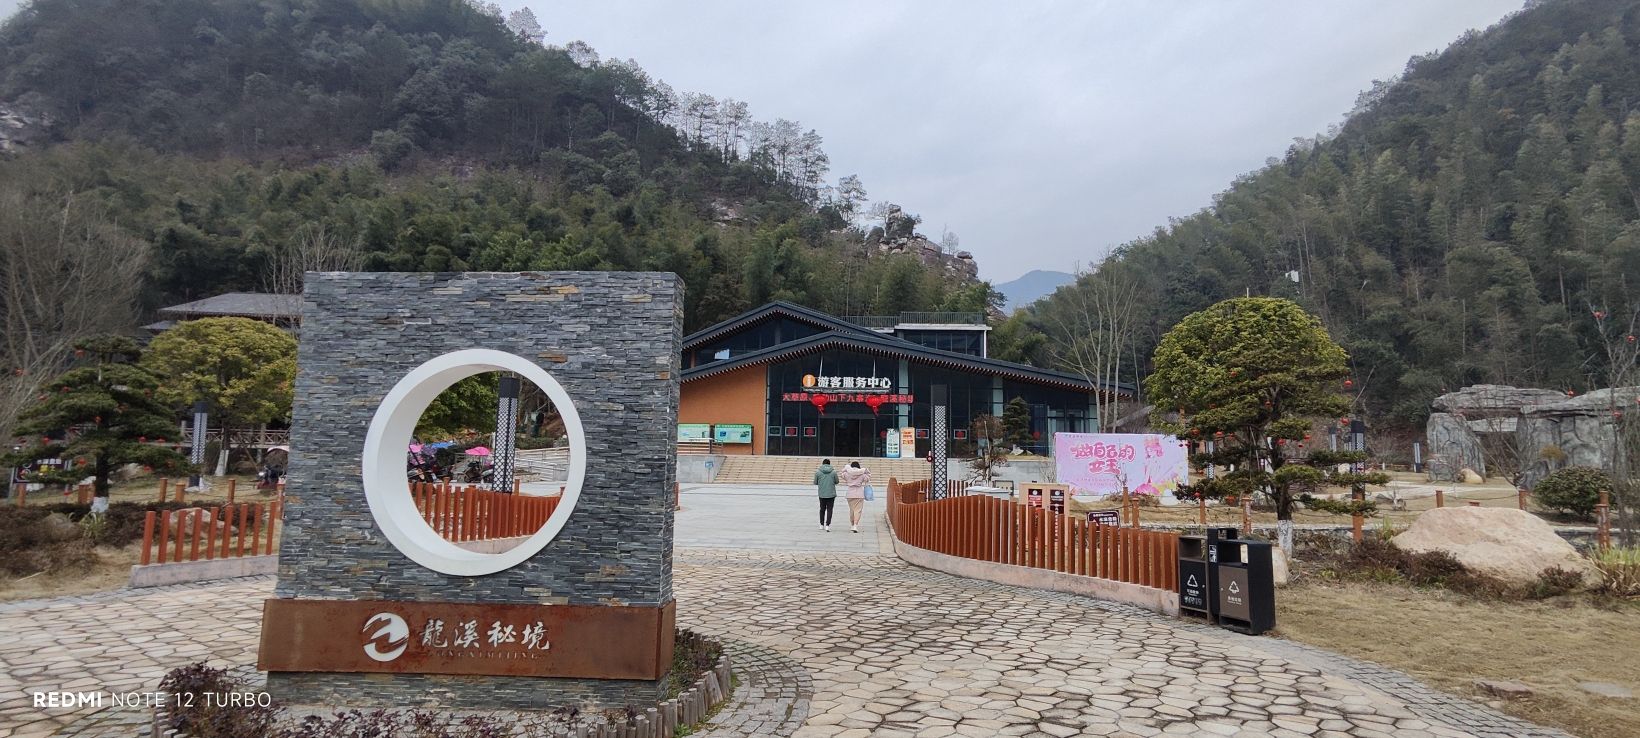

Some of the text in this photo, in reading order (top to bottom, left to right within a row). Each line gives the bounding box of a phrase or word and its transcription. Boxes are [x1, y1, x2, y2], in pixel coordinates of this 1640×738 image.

[817, 376, 892, 389] 游客服务中心
[1070, 442, 1136, 462] 做自己的
[1089, 459, 1121, 475] 女王
[419, 617, 550, 650] 龍溪秘境
